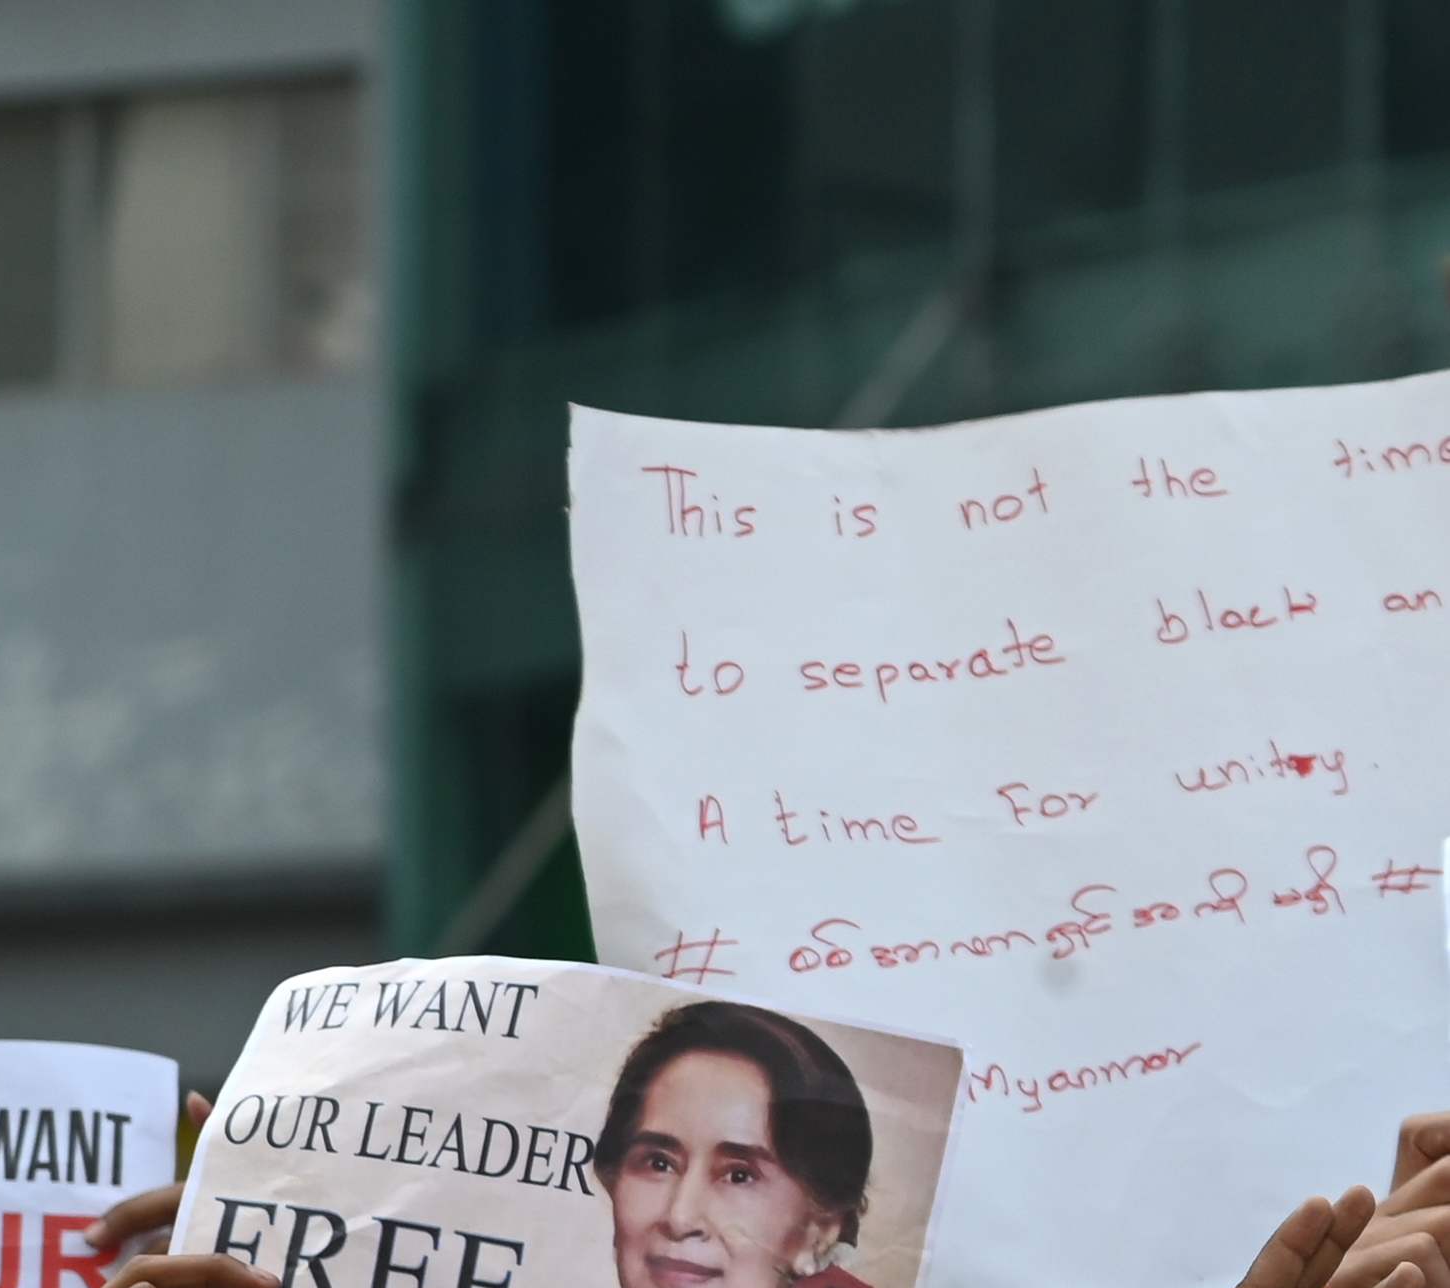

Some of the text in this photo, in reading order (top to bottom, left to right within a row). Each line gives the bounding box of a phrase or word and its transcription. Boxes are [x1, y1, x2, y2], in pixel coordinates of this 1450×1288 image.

[641, 465, 758, 540] This
[833, 496, 878, 540] is
[959, 468, 1050, 533] not
[1131, 455, 1228, 499] the
[677, 631, 746, 698] to
[801, 618, 1068, 703] separate
[1157, 586, 1317, 643] black
[696, 796, 729, 846] A
[775, 789, 943, 848] time
[654, 927, 739, 985] #
[284, 980, 538, 1039] WE WANT
[224, 1094, 596, 1196] OUR LEADER
